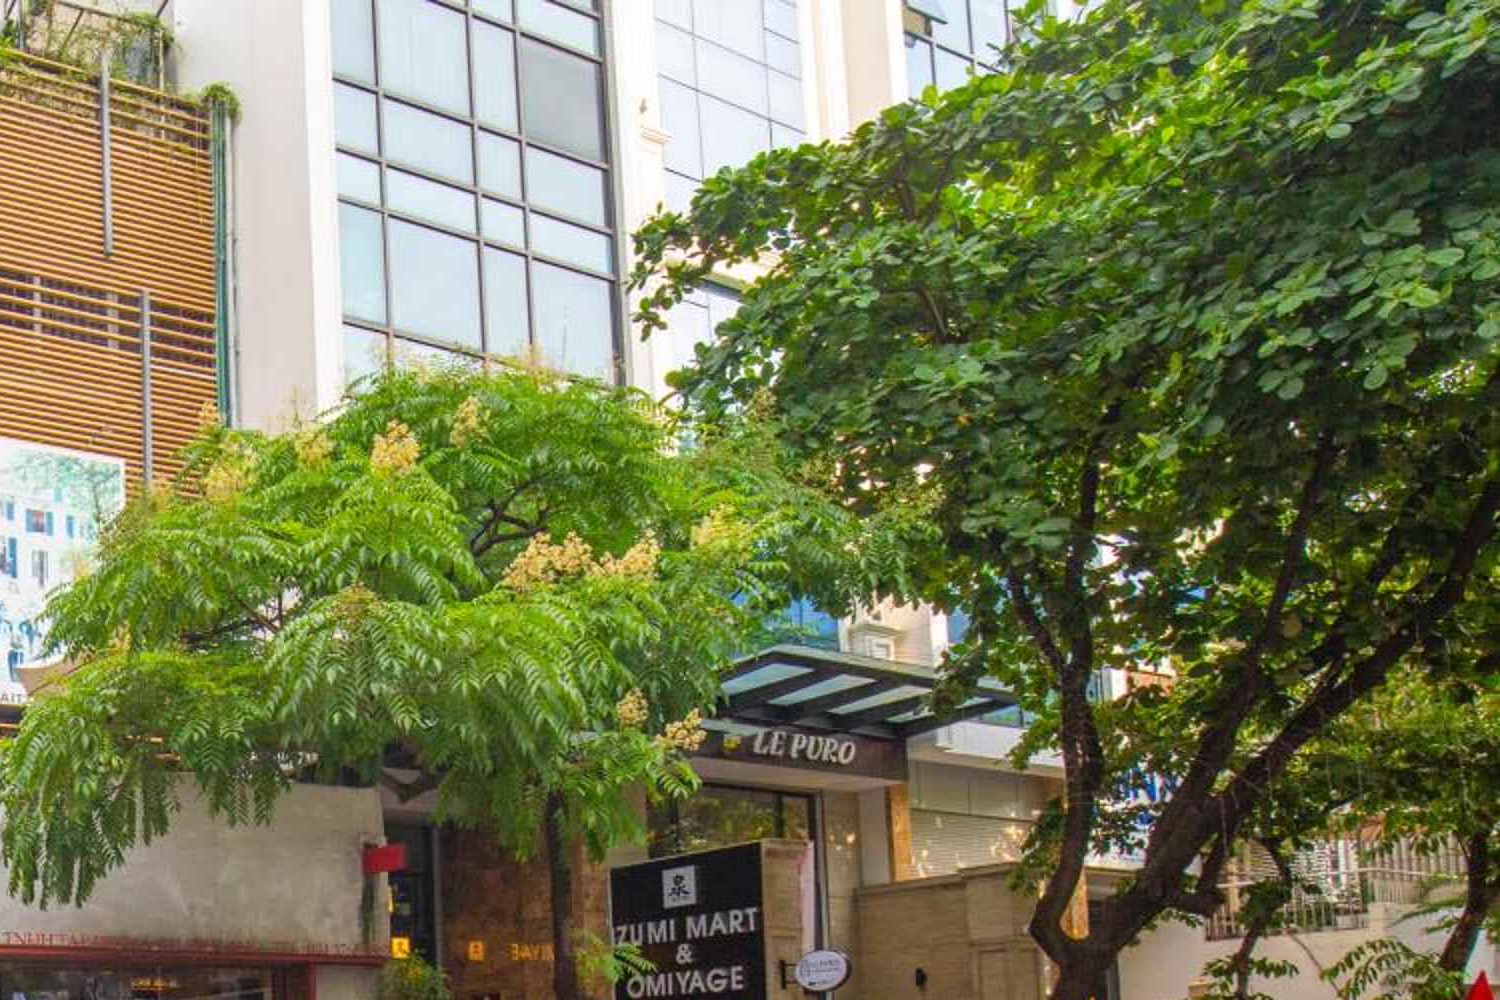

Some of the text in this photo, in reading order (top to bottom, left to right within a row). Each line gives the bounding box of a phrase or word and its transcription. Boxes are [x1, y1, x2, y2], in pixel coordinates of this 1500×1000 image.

[753, 729, 856, 764] LE PURO
[686, 907, 758, 939] MART
[675, 943, 693, 964] &
[627, 966, 744, 998] OMIYAGE
